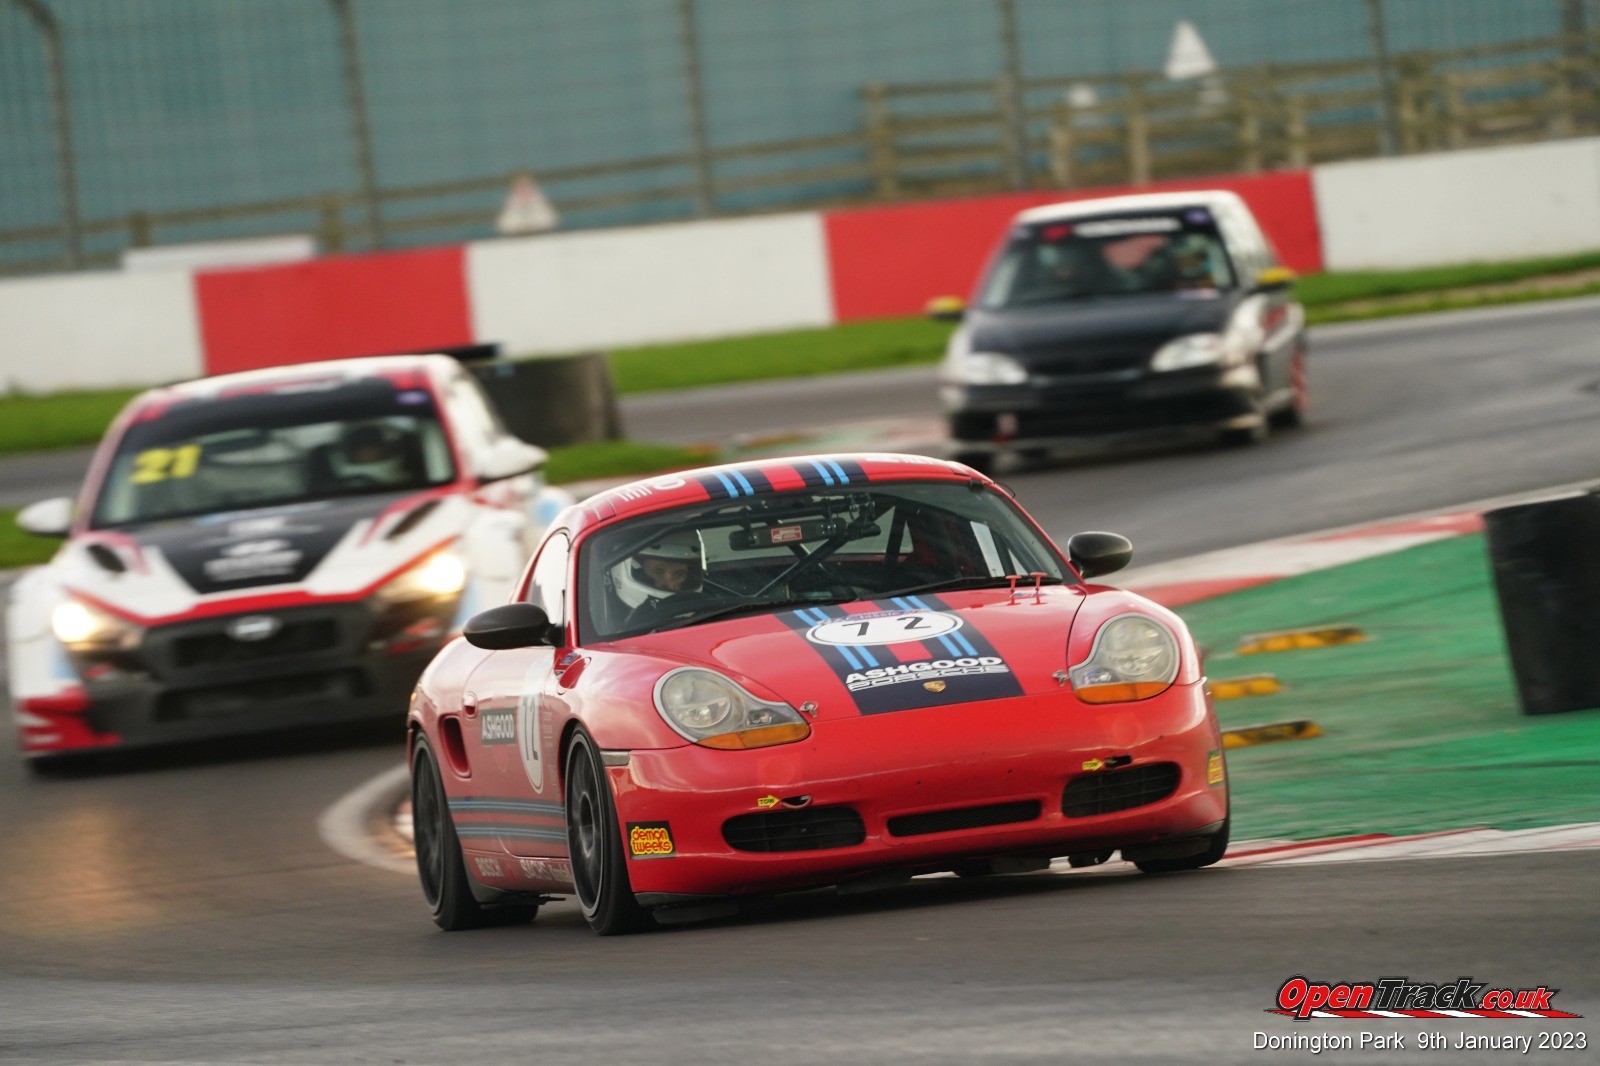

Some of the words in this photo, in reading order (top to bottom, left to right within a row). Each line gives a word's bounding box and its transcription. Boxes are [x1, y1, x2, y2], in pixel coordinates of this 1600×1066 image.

[130, 443, 202, 484] 21
[846, 656, 1003, 684] ASHGOOD
[847, 664, 1011, 692] PORSCHE
[482, 713, 515, 740] ASHGOOD
[631, 826, 669, 840] demon
[631, 840, 673, 854] tweeks
